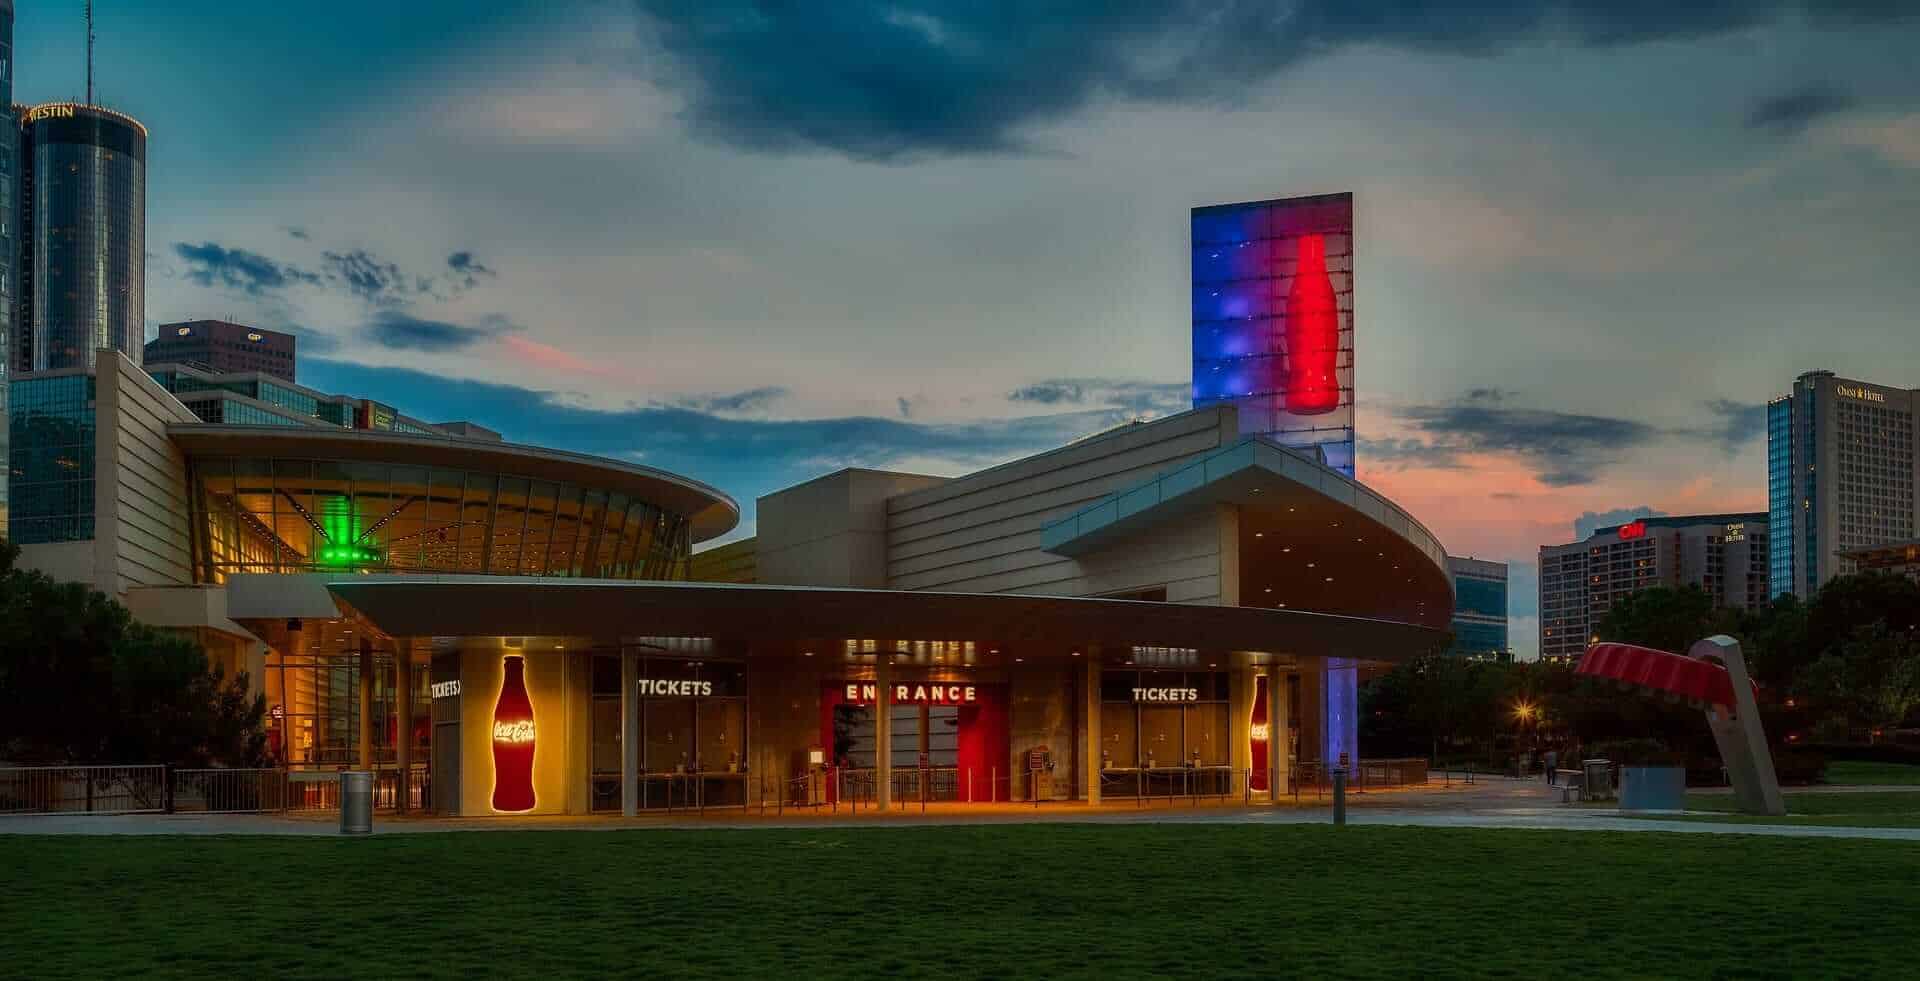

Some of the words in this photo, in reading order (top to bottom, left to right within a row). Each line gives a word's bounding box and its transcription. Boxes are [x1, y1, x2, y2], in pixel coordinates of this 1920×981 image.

[431, 679, 457, 698] TICKETS
[638, 679, 712, 696] TICKETS
[846, 684, 976, 701] ENRANCE
[1132, 687, 1198, 701] TICKETS
